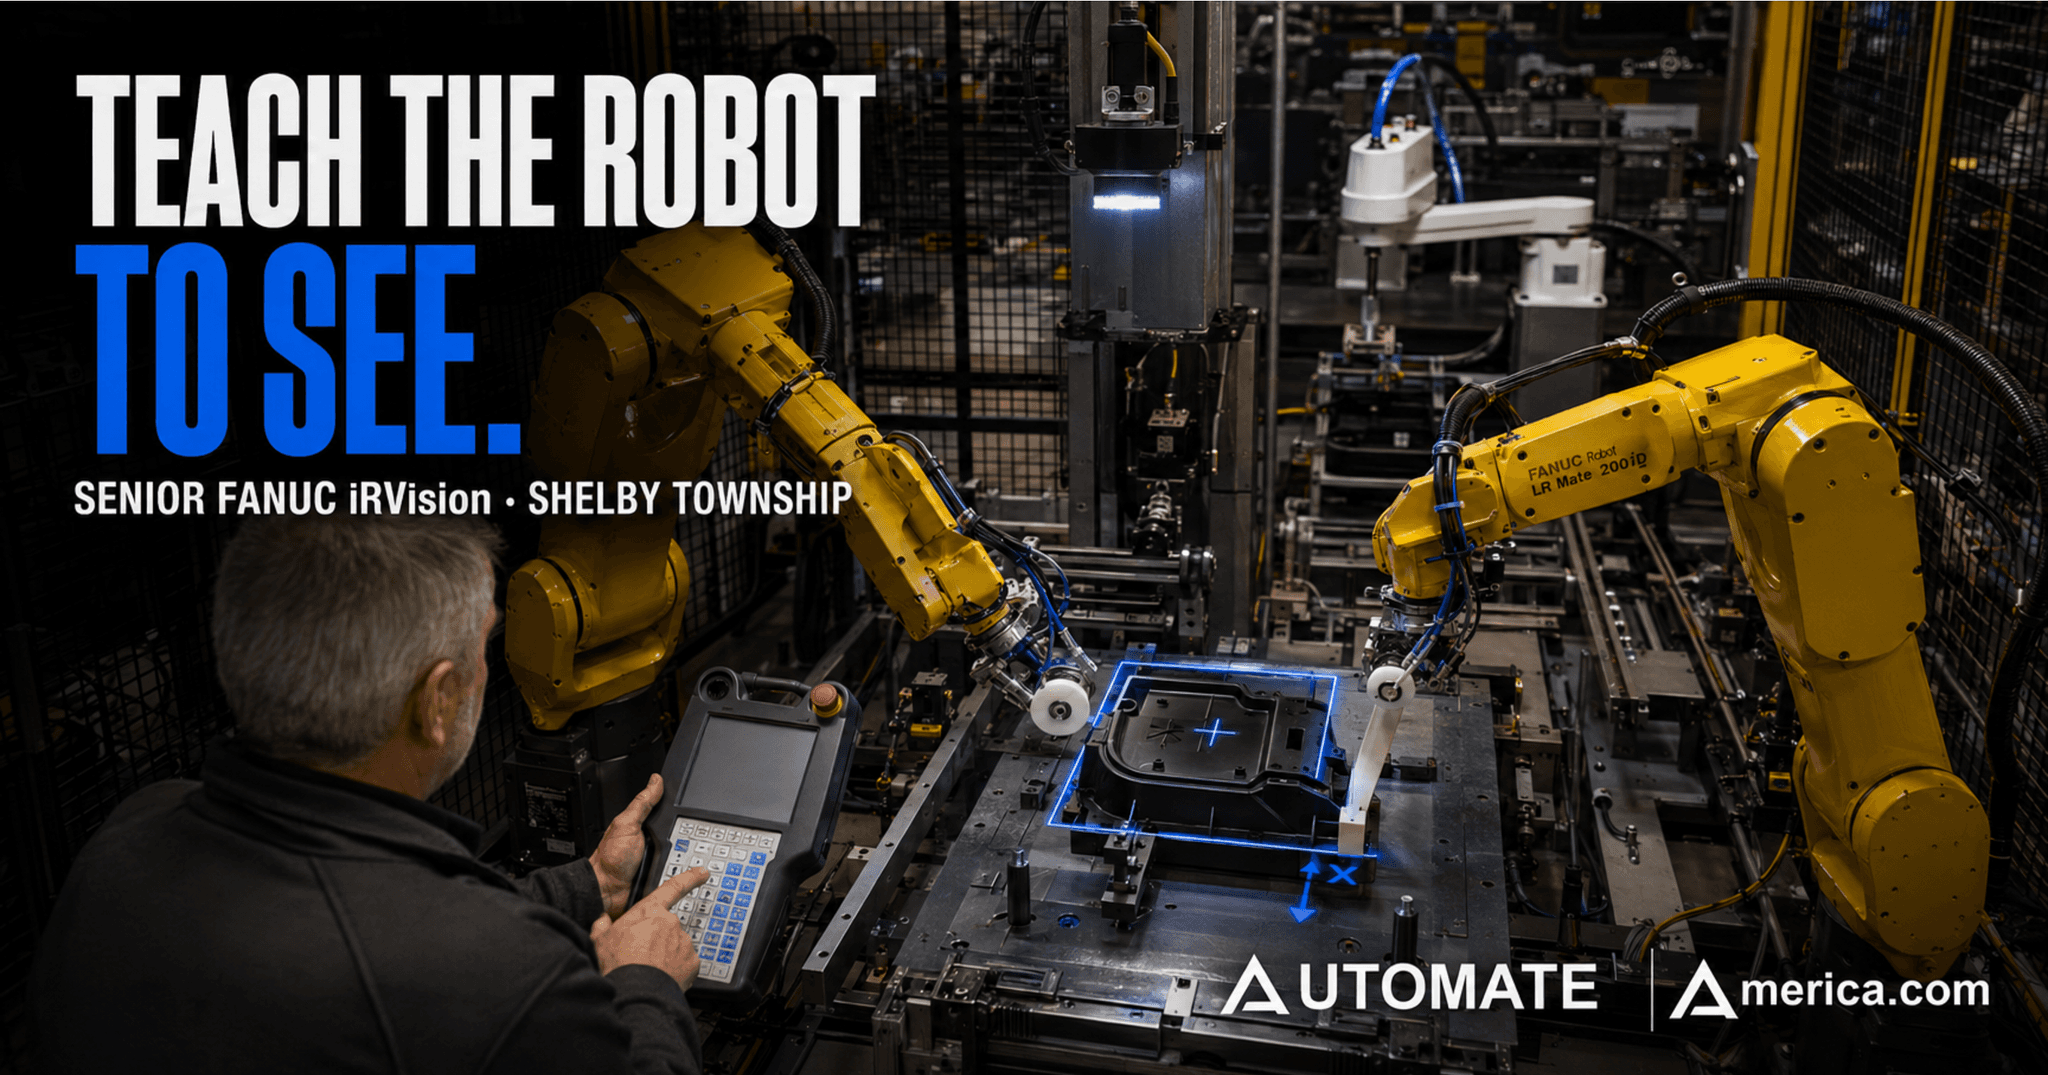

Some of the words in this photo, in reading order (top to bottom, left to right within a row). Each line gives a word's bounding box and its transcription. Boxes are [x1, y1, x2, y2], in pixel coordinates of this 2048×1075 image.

[1528, 455, 1583, 481] FANUC
[1586, 445, 1617, 463] Robot
[1531, 480, 1552, 497] LR
[1556, 470, 1593, 489] Mate
[1600, 451, 1647, 477] 200iD
